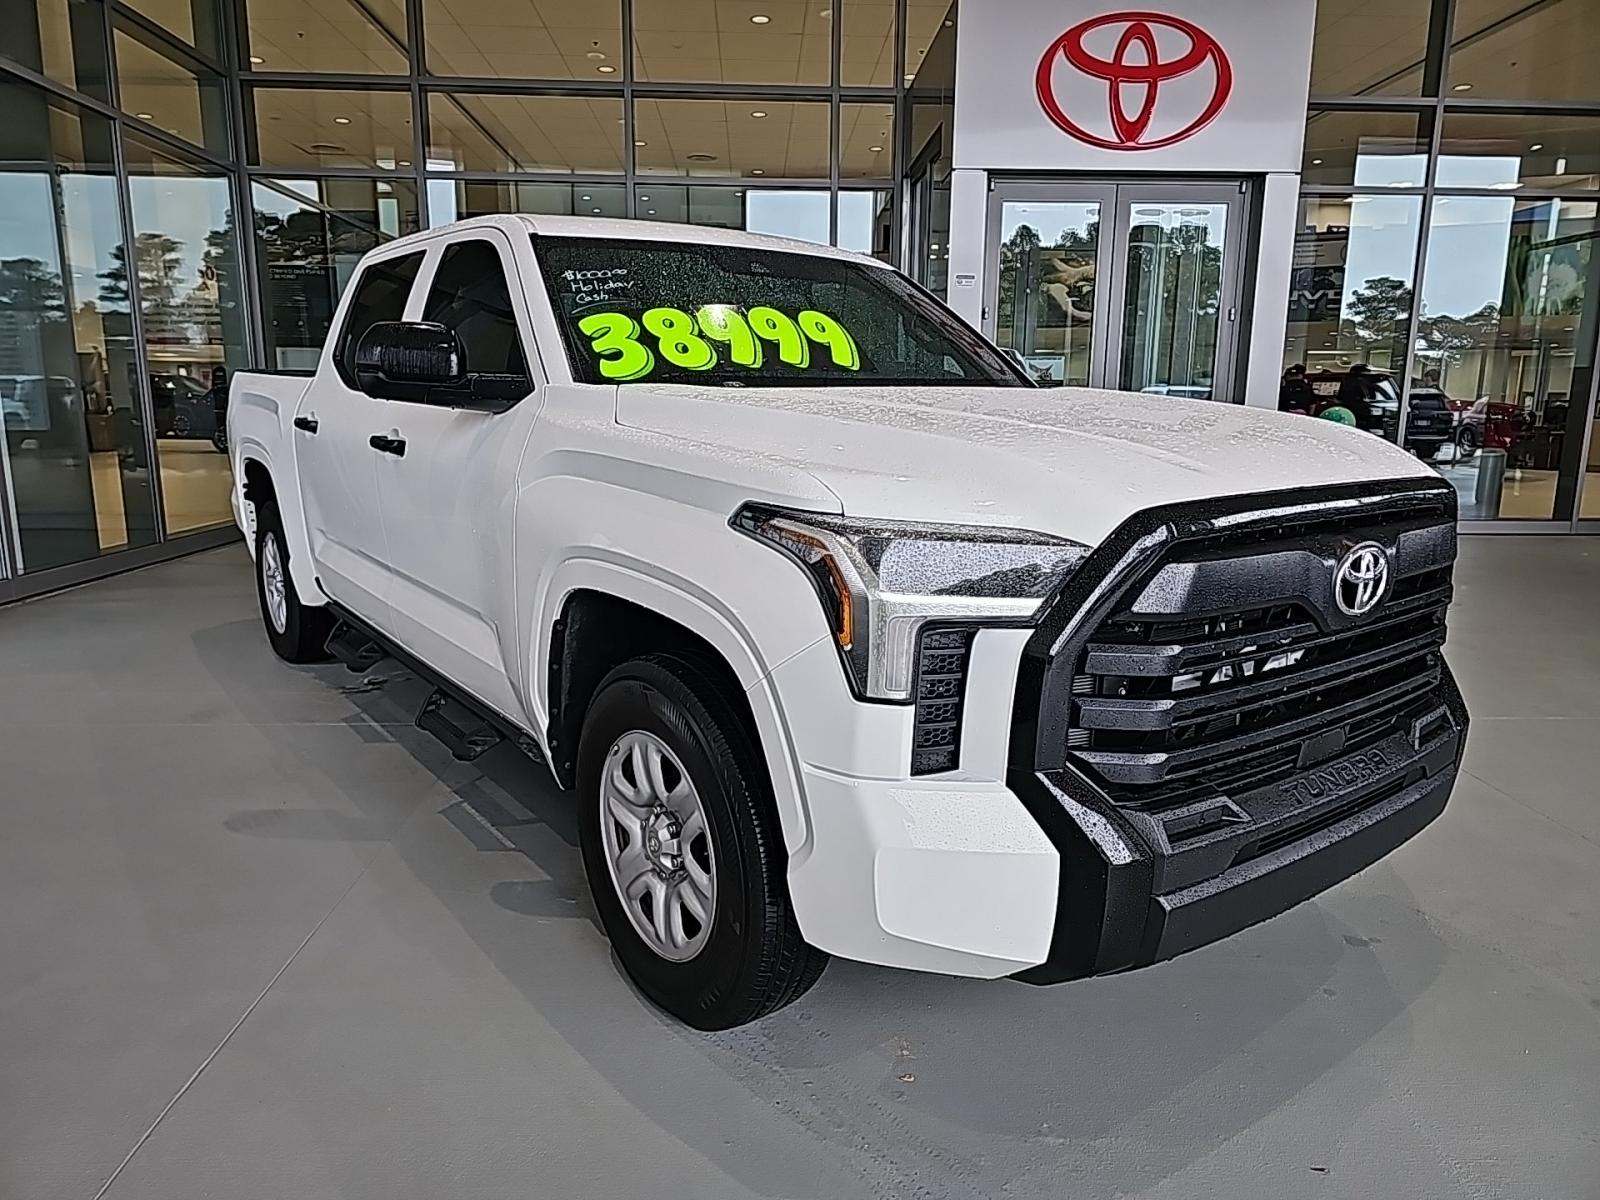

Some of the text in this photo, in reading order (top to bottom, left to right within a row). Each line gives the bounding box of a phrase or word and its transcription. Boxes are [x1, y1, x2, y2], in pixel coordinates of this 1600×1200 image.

[570, 280, 635, 292] Holiday
[576, 291, 609, 304] Cash
[578, 304, 860, 380] 38999
[1279, 749, 1399, 804] TUNDRA
